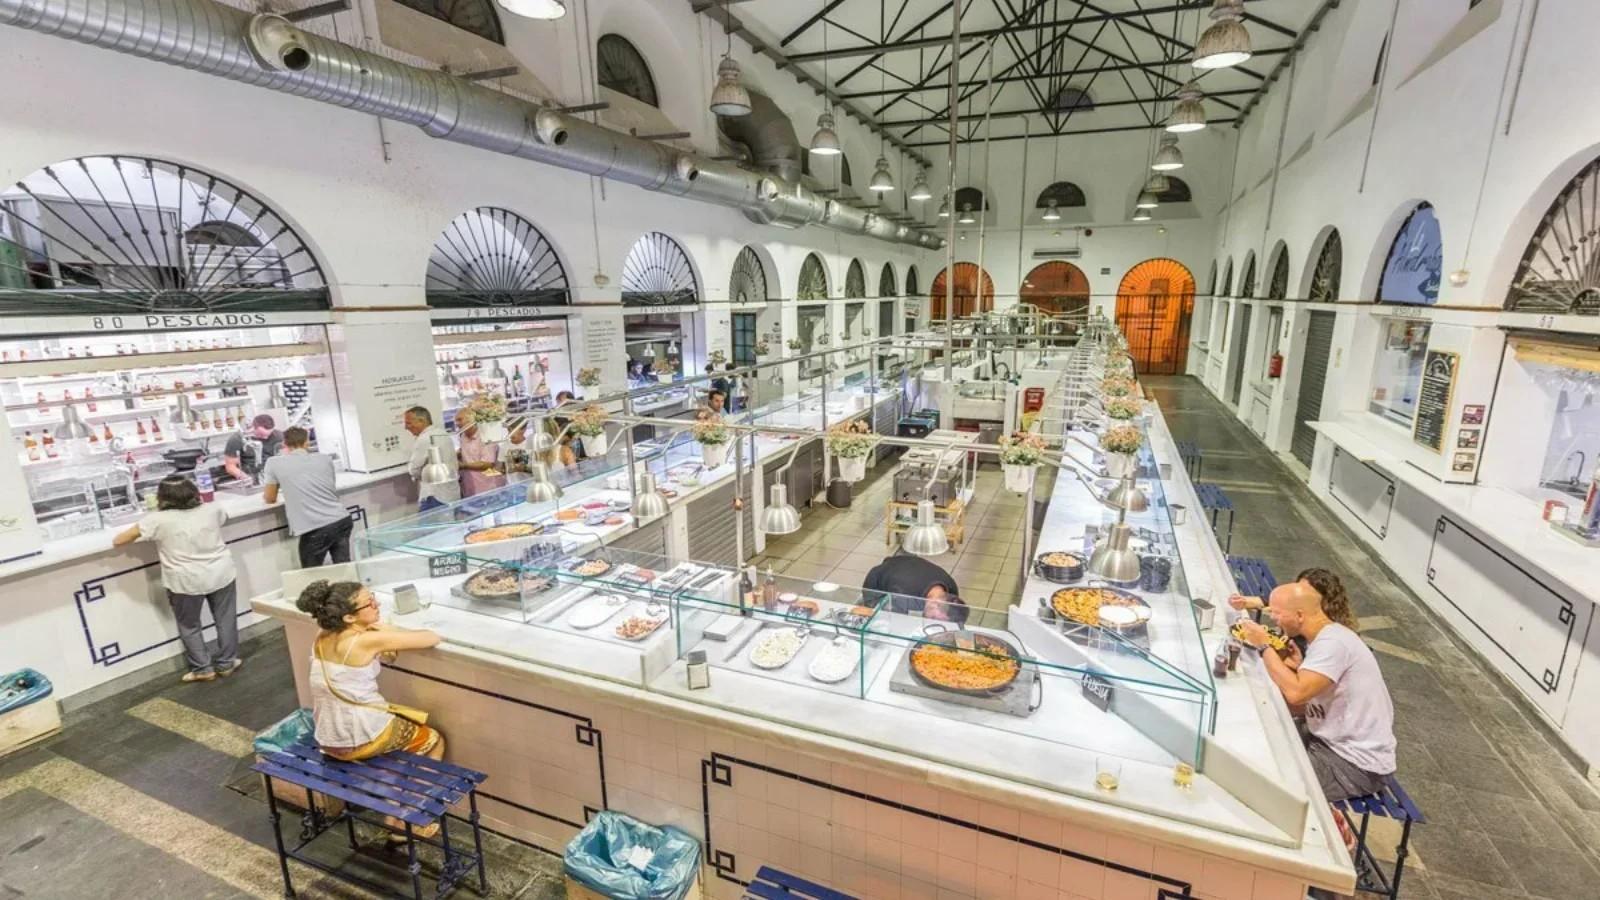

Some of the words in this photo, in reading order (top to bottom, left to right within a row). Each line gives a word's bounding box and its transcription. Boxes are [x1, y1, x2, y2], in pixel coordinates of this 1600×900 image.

[488, 307, 541, 316] PESCADOS
[93, 316, 123, 329] 80
[145, 313, 266, 328] PESCADOS
